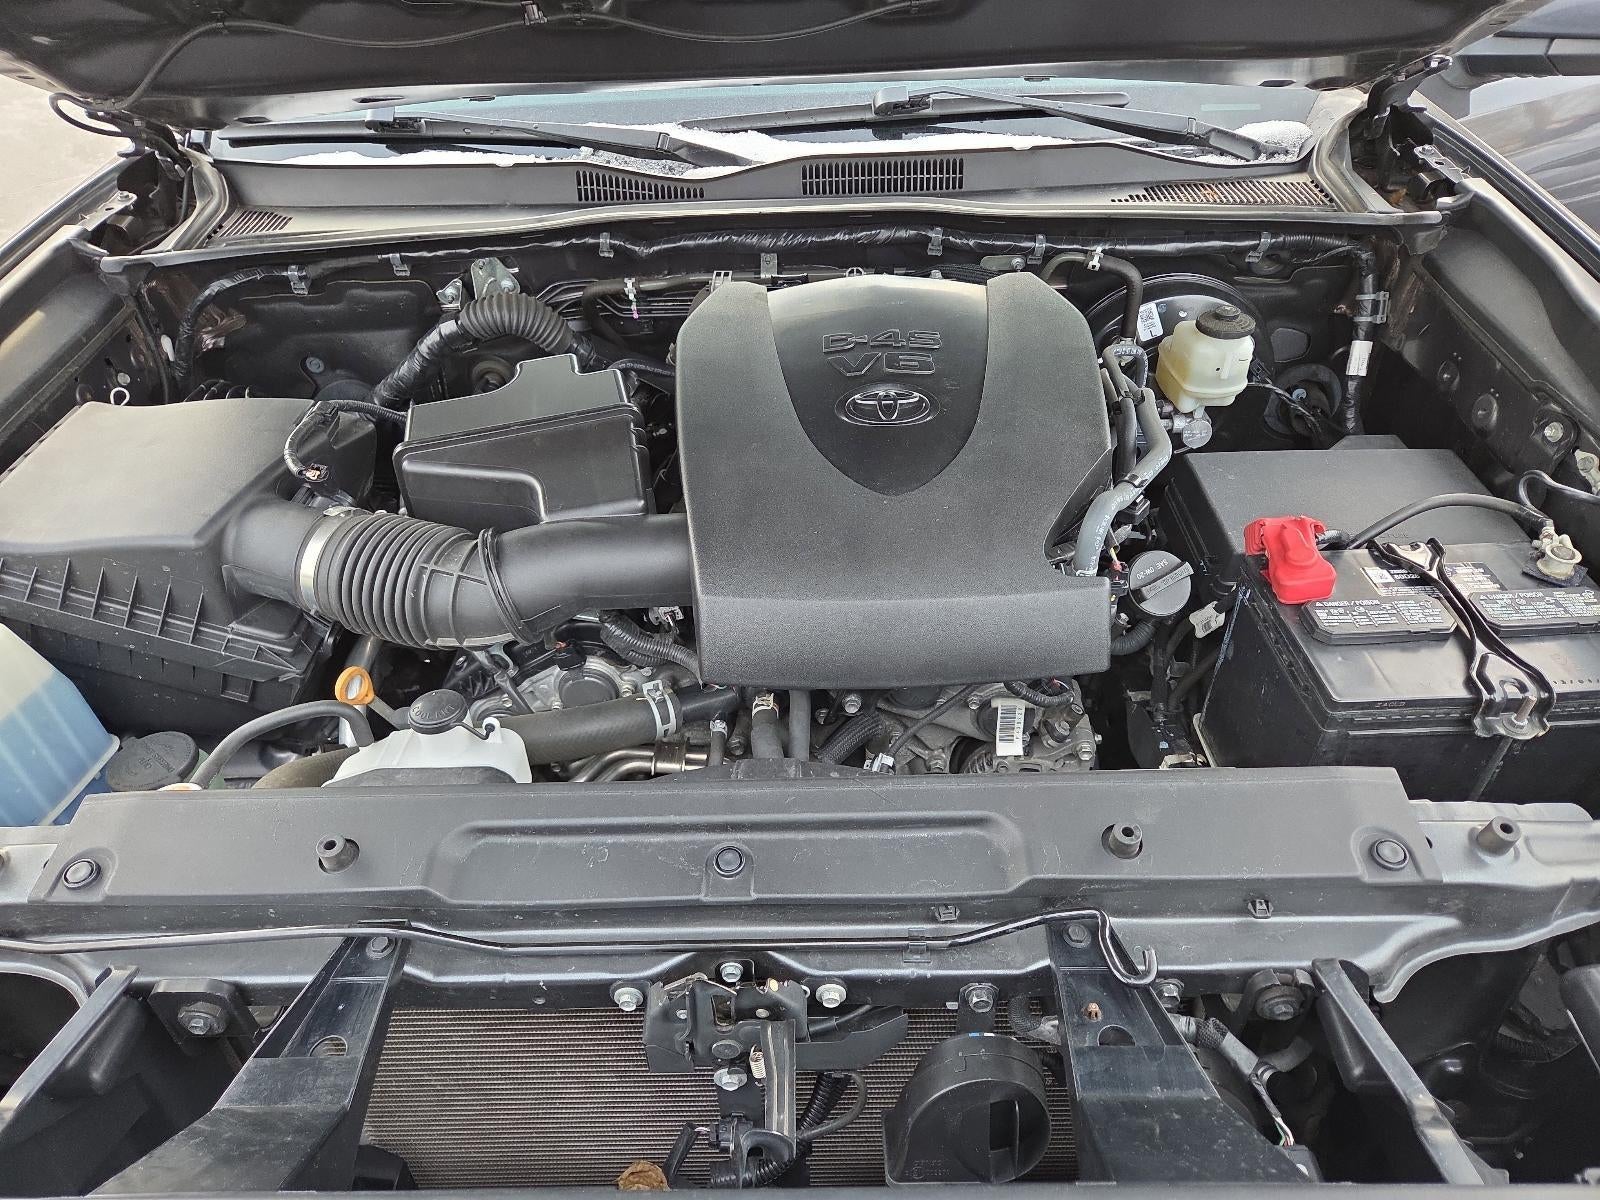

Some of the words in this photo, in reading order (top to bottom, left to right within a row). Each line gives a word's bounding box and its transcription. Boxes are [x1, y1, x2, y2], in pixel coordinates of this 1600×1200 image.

[822, 329, 942, 353] D-4S
[825, 352, 936, 377] V6
[1136, 566, 1155, 580] 0W-20
[1155, 558, 1169, 570] SAE
